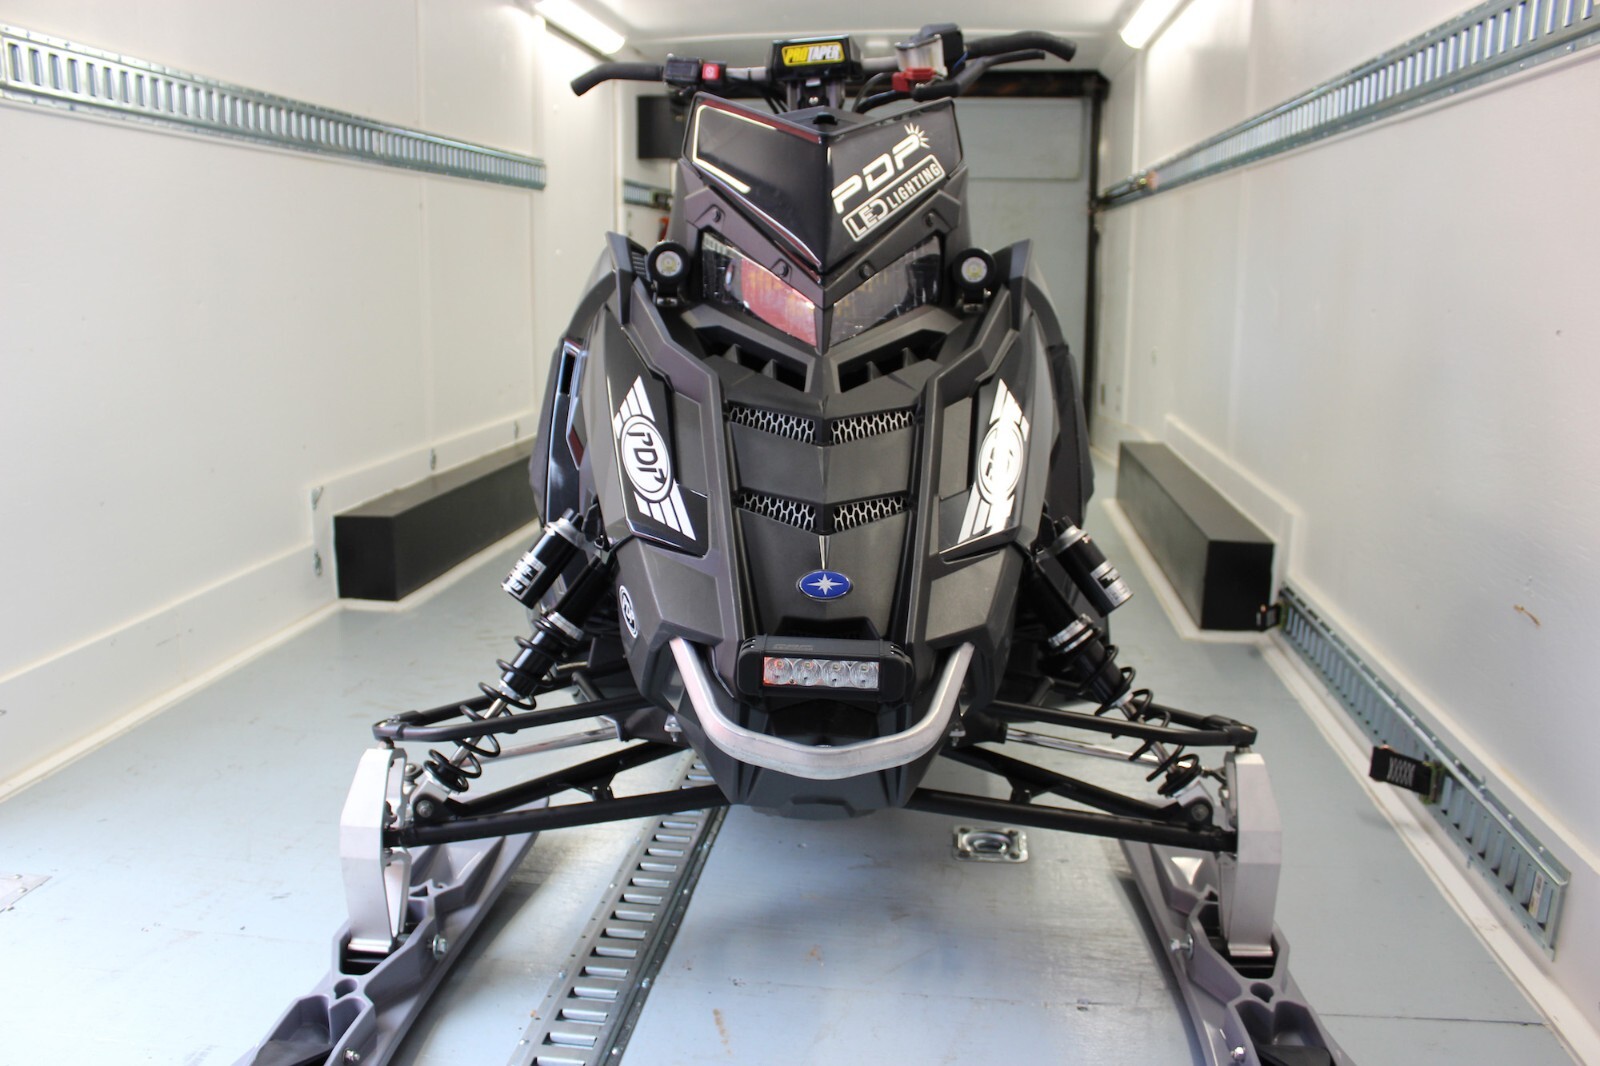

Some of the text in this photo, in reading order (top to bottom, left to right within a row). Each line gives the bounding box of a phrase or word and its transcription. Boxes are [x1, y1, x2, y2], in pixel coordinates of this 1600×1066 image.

[831, 134, 920, 214] PDP
[848, 163, 941, 236] LED LIGHTING
